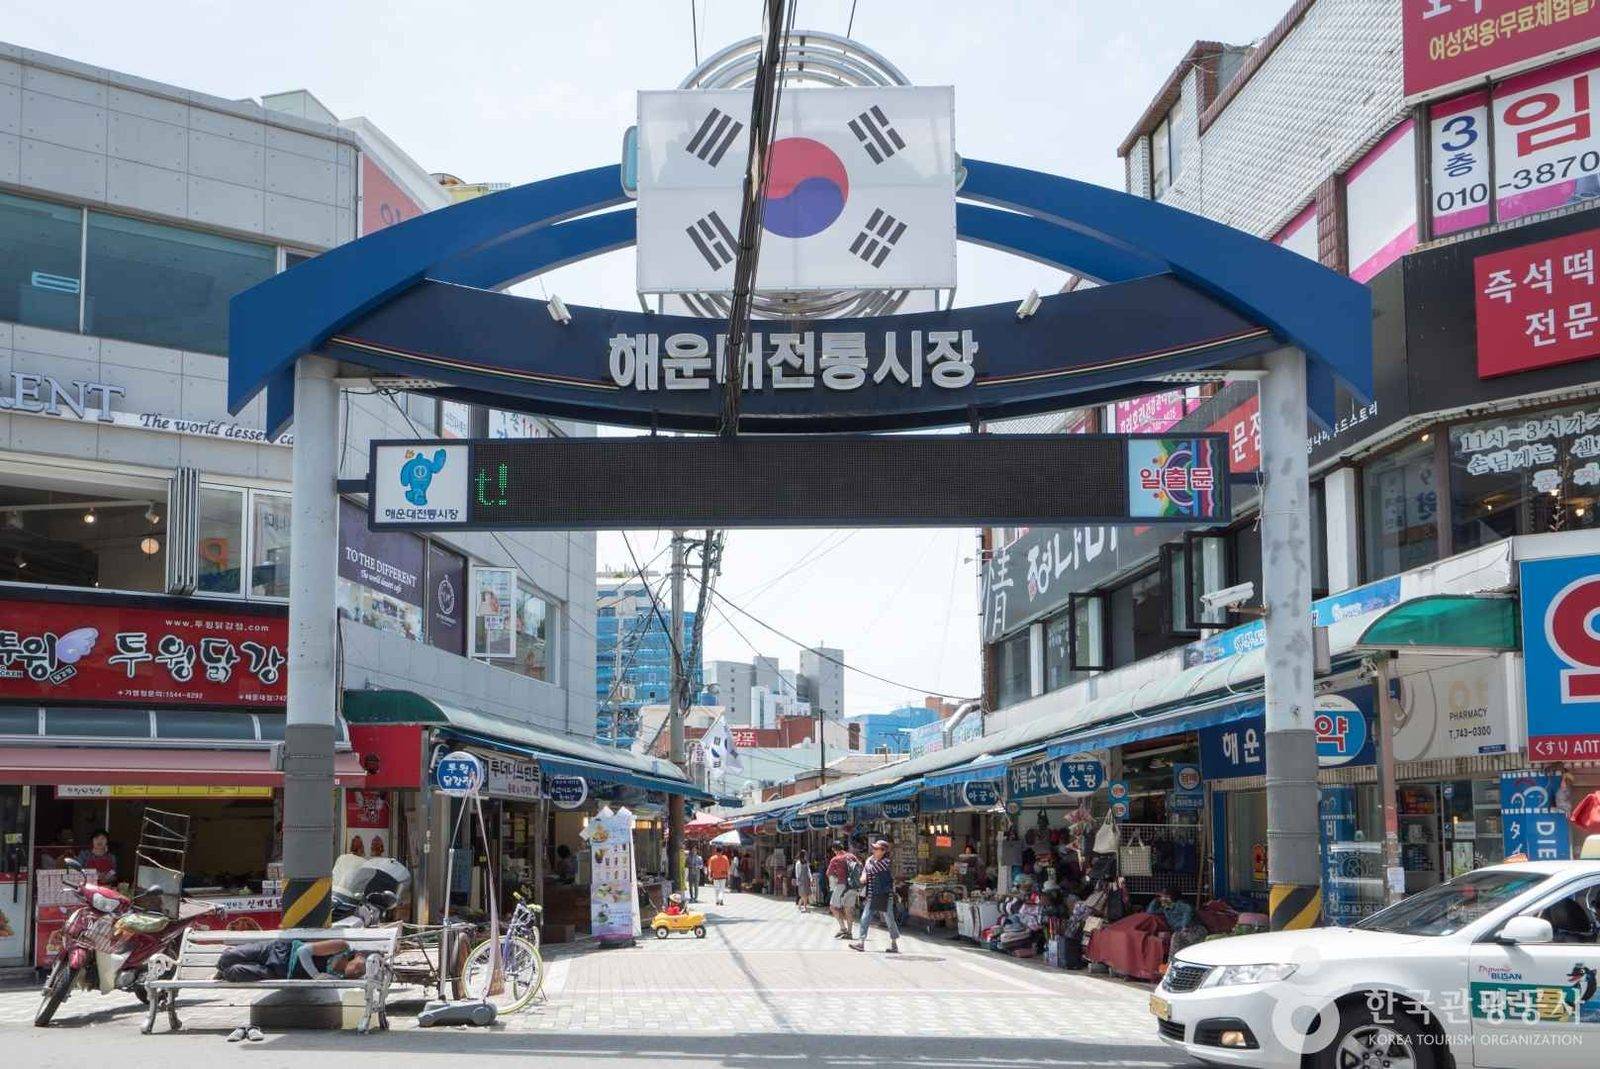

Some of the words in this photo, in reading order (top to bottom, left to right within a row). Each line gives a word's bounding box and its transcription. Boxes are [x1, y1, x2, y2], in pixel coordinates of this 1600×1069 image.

[1441, 115, 1478, 151] 3
[1503, 74, 1591, 157] 임
[1443, 152, 1476, 177] 층
[1436, 183, 1488, 212] 010
[1484, 248, 1595, 304] 즉석떡
[1525, 301, 1599, 347] 전문
[608, 329, 979, 391] 해운대전통시장
[0, 371, 127, 422] ENT
[139, 413, 169, 429] The
[175, 419, 222, 435] world
[385, 508, 459, 520] 해운대전통시장
[345, 547, 358, 562] TO
[359, 552, 376, 570] THE
[376, 560, 418, 587] DIFFERENT
[1449, 707, 1488, 721] PHARMACY
[1222, 728, 1260, 765] 해운
[1314, 716, 1348, 753] 약
[1535, 740, 1568, 756] くすり
[1490, 972, 1522, 981] BUSAN
